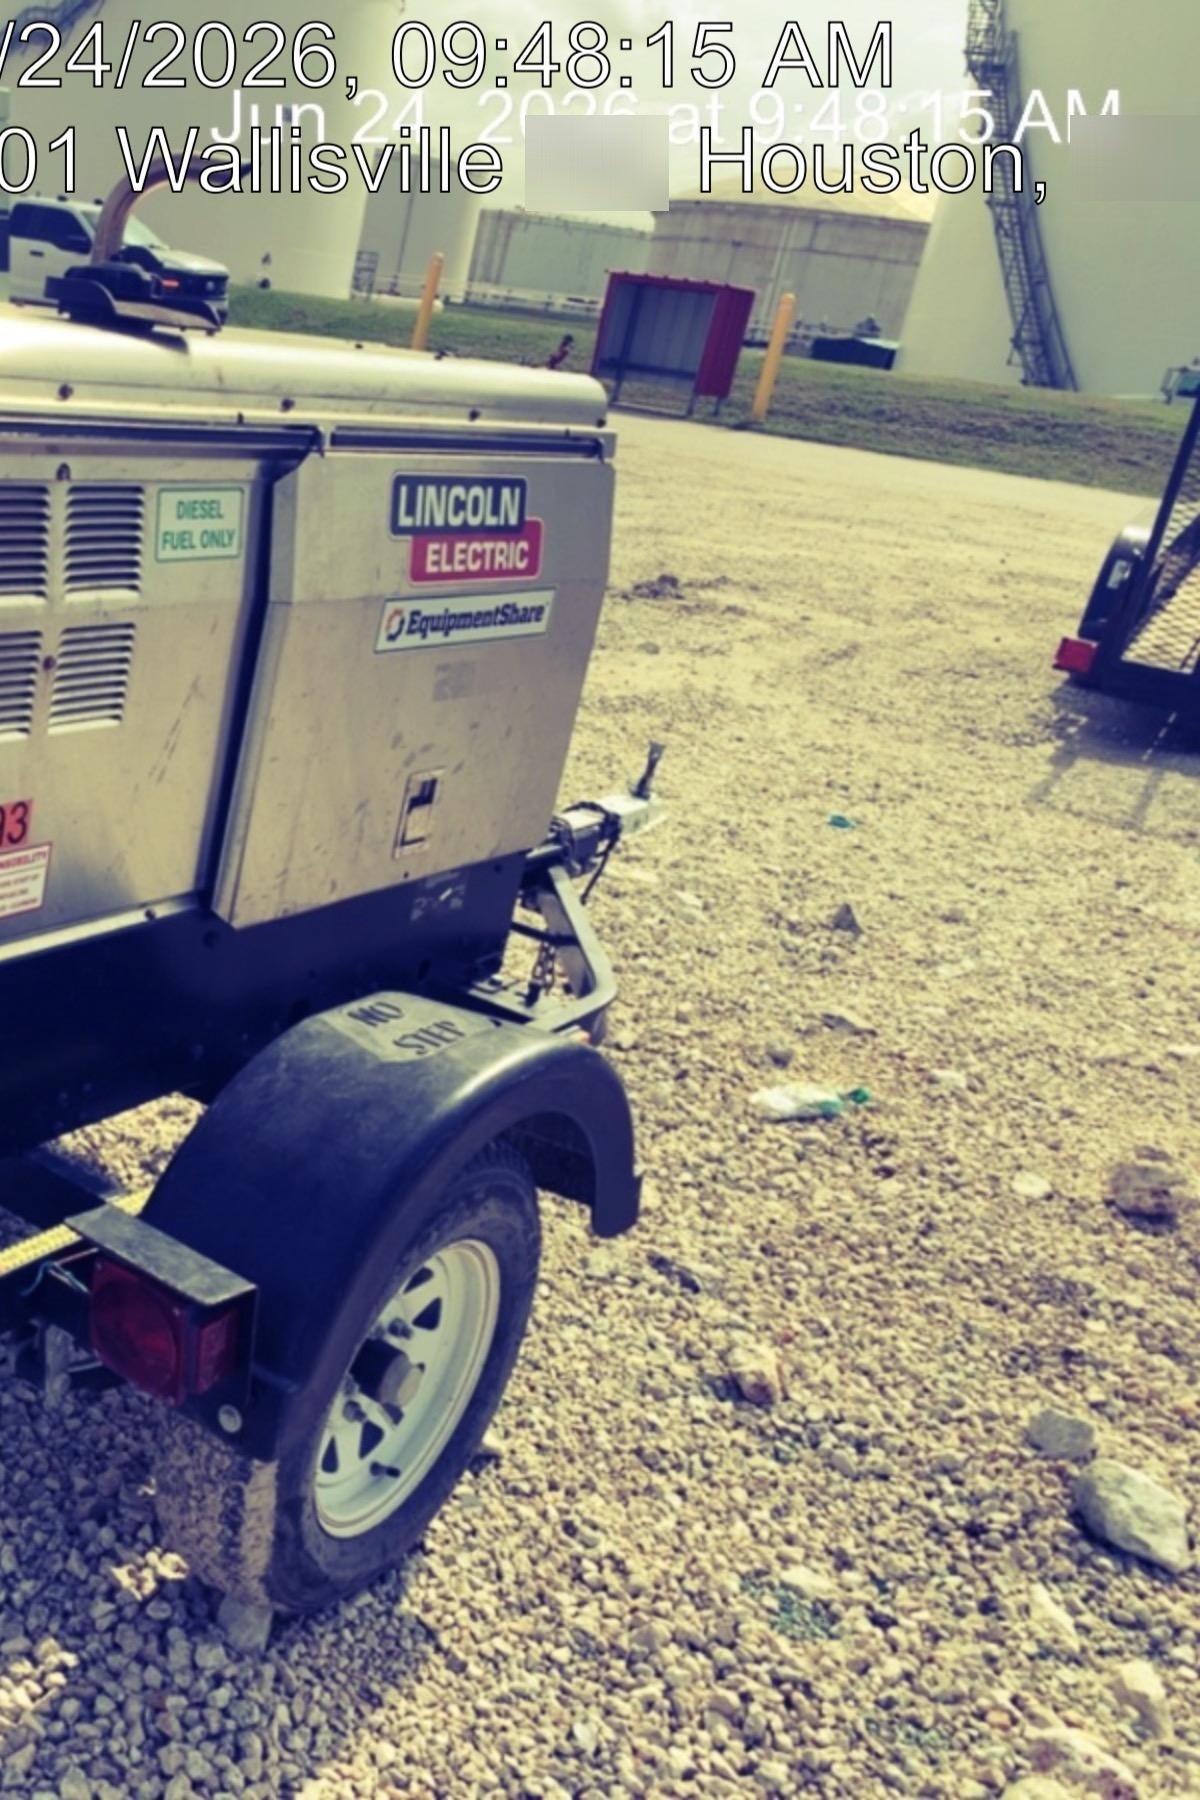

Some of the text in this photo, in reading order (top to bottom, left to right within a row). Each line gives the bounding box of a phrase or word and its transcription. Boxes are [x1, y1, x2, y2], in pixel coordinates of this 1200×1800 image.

[176, 499, 225, 520] DIESEL
[397, 484, 521, 527] LINCOLN
[161, 528, 236, 550] FUEL ONLY
[425, 541, 530, 573] ELECTRIC
[406, 602, 546, 640] EquipmentShare
